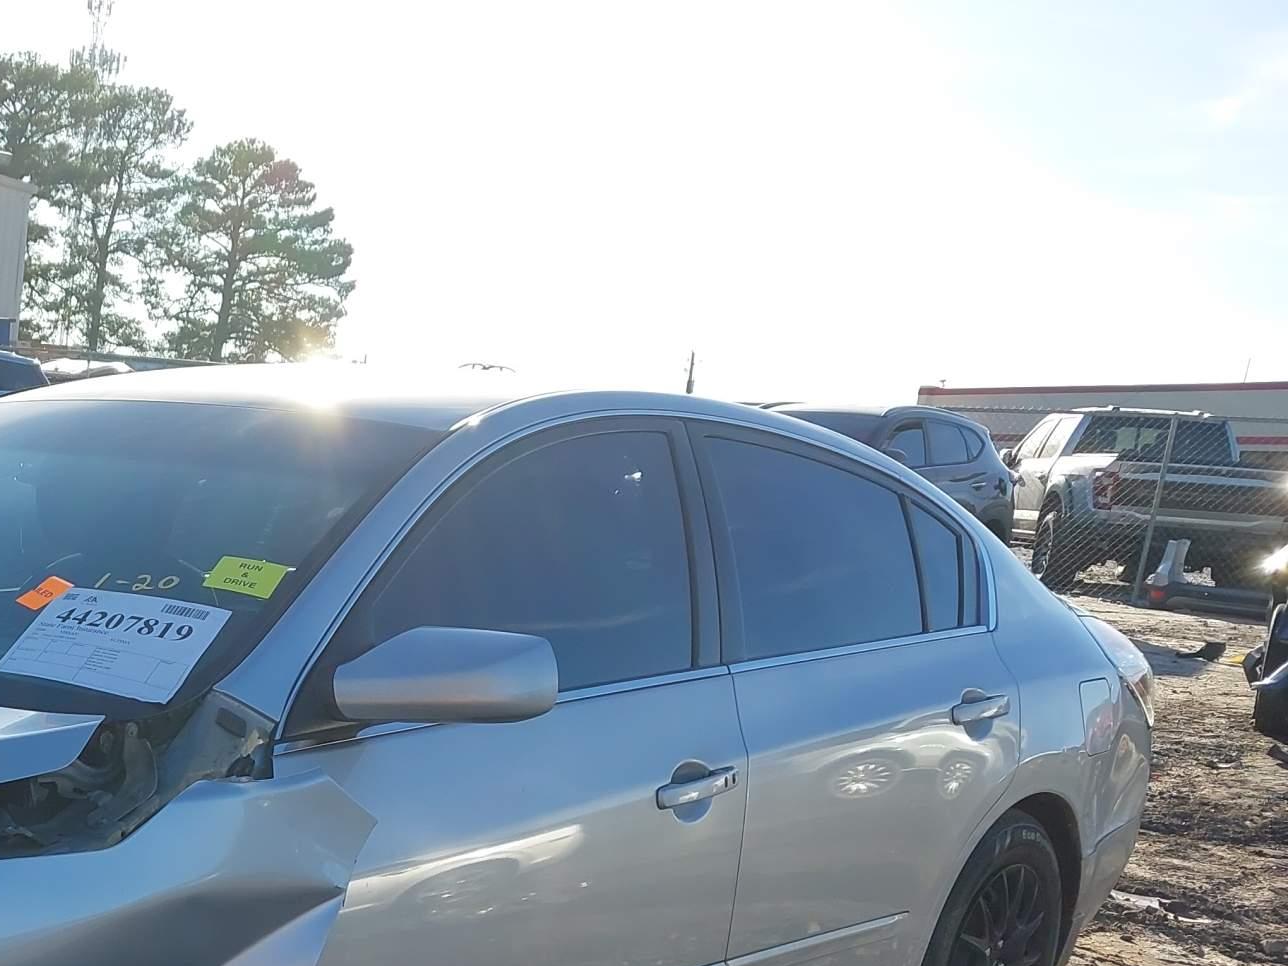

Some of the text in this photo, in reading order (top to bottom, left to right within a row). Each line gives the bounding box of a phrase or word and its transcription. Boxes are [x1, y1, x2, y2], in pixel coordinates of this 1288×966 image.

[239, 562, 264, 572] RUN
[94, 572, 179, 591] 1-20
[223, 577, 257, 588] DRIVE
[56, 607, 193, 641] 44207819
